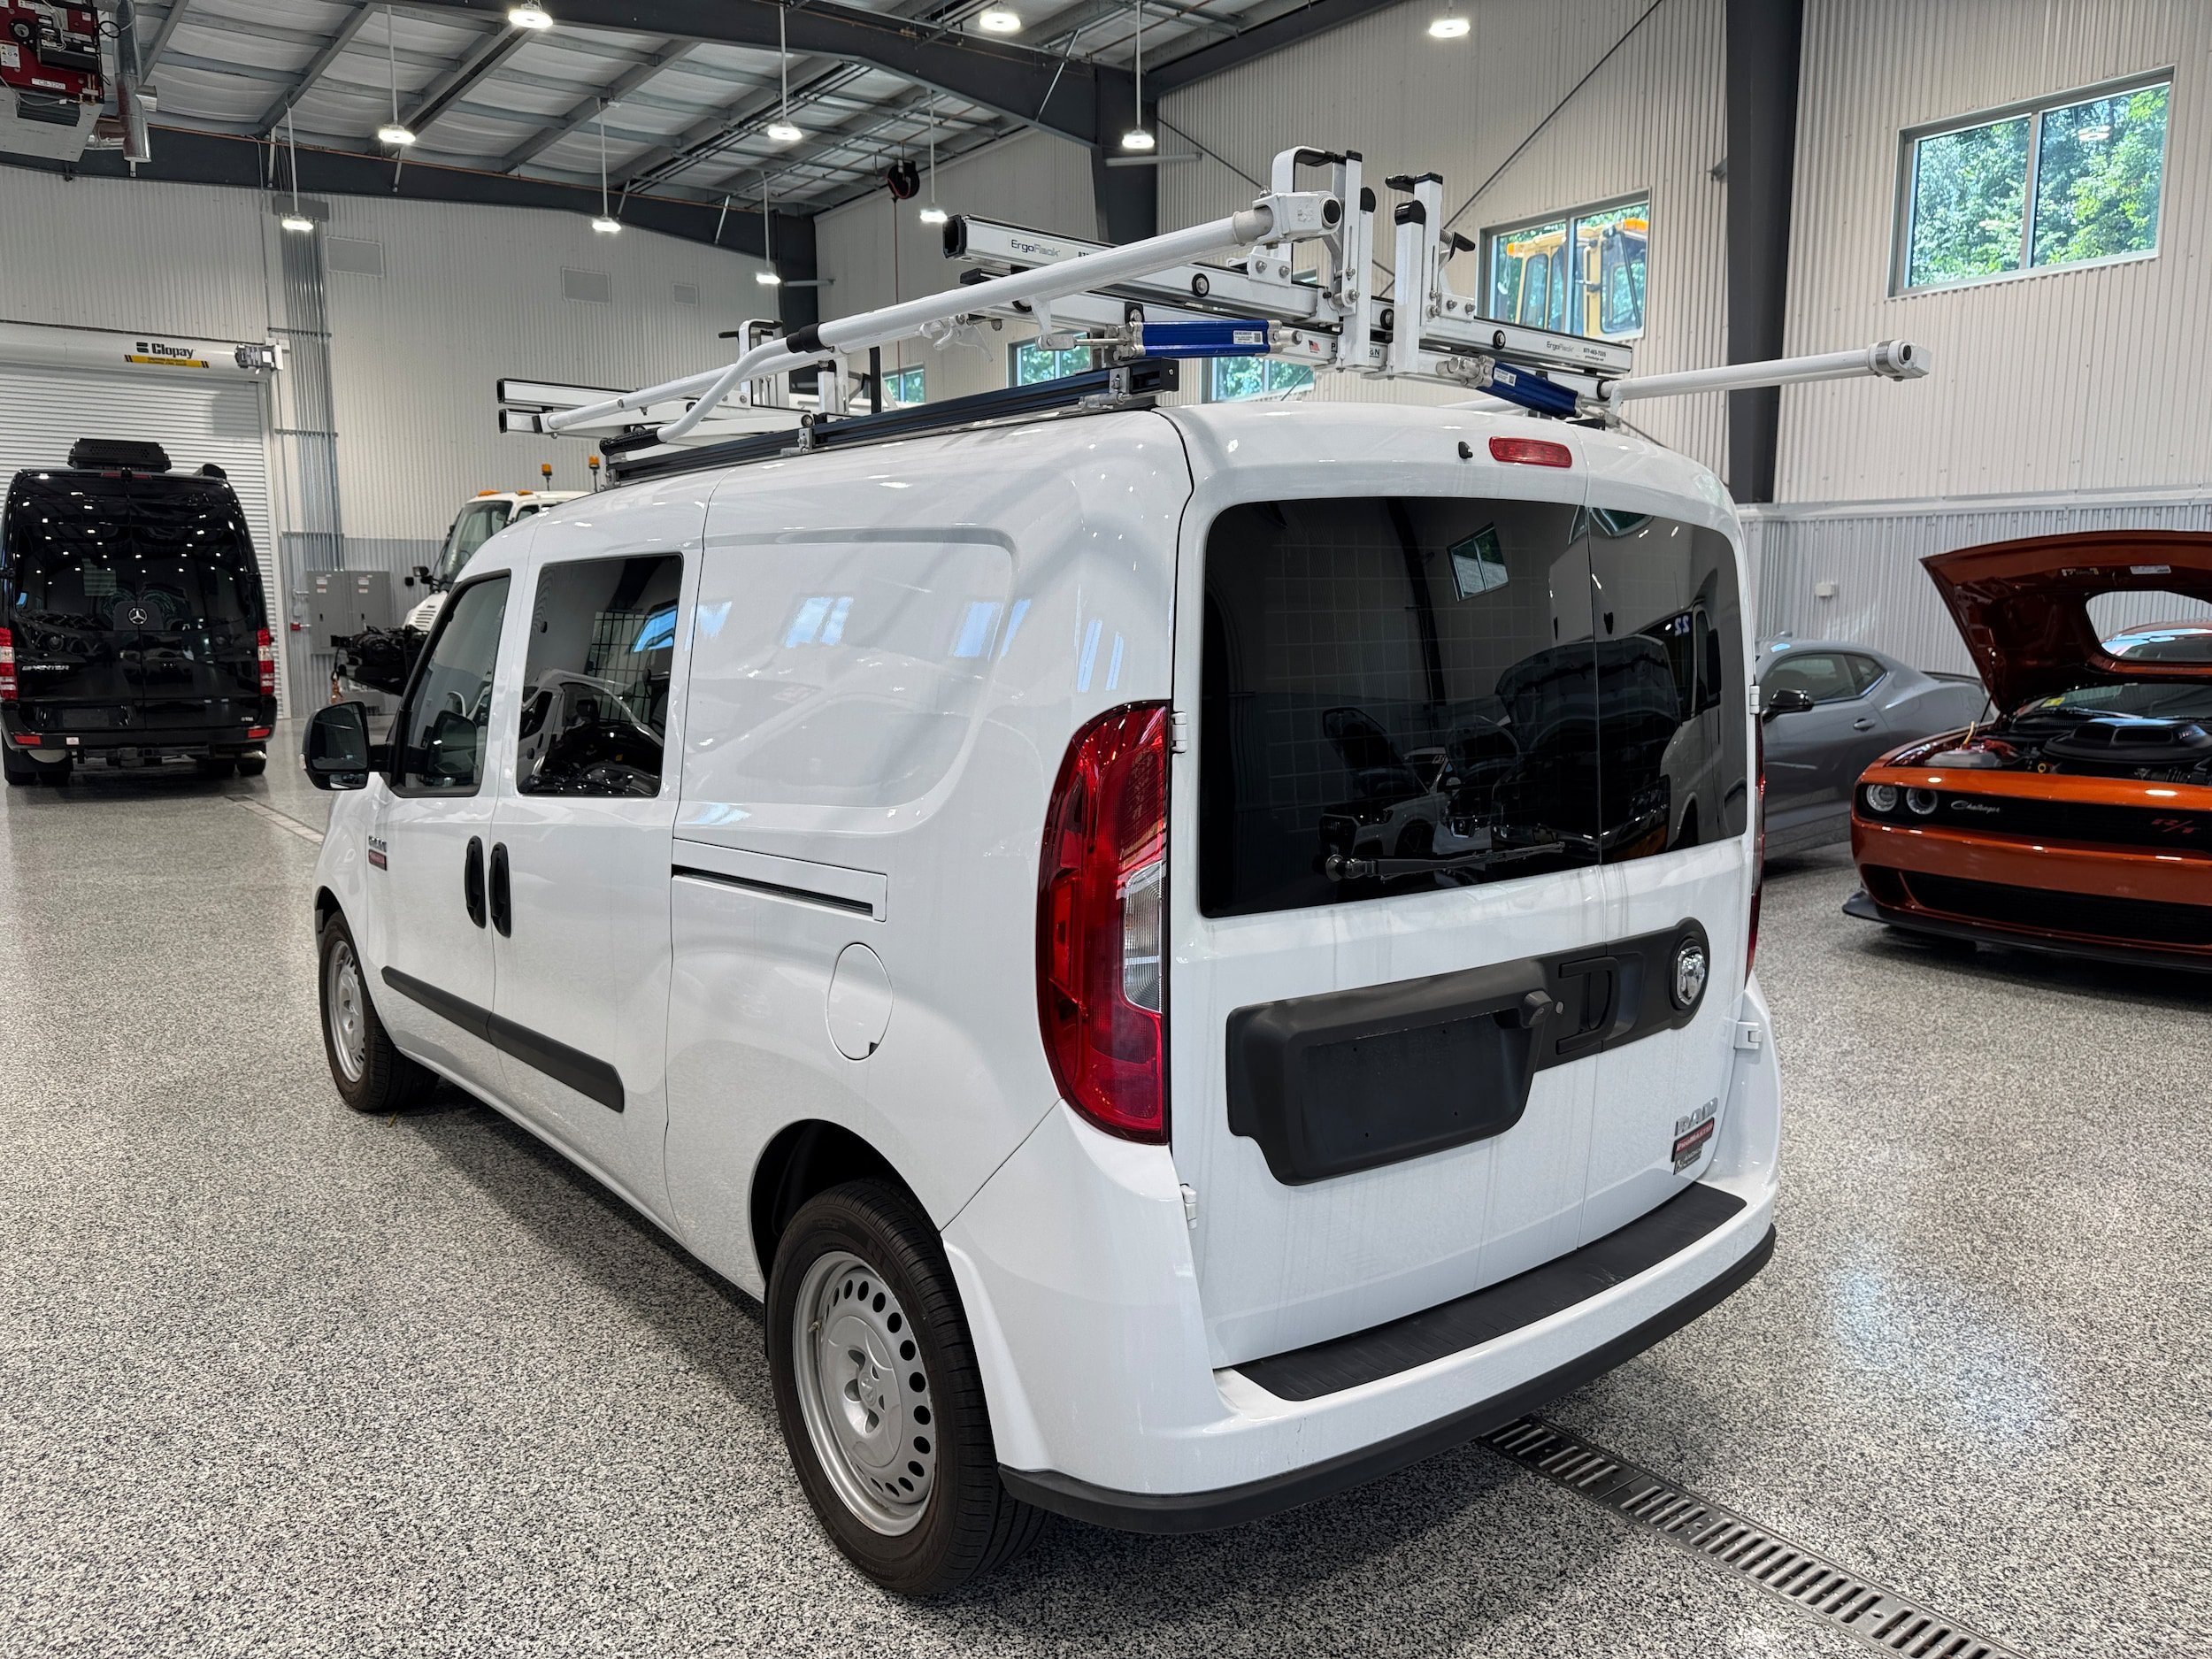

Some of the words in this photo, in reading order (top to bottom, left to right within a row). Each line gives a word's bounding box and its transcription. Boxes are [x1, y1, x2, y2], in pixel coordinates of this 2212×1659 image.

[1010, 239, 1059, 257] ErgoRack
[151, 342, 194, 359] Clopay
[1674, 1097, 1718, 1138] RAM
